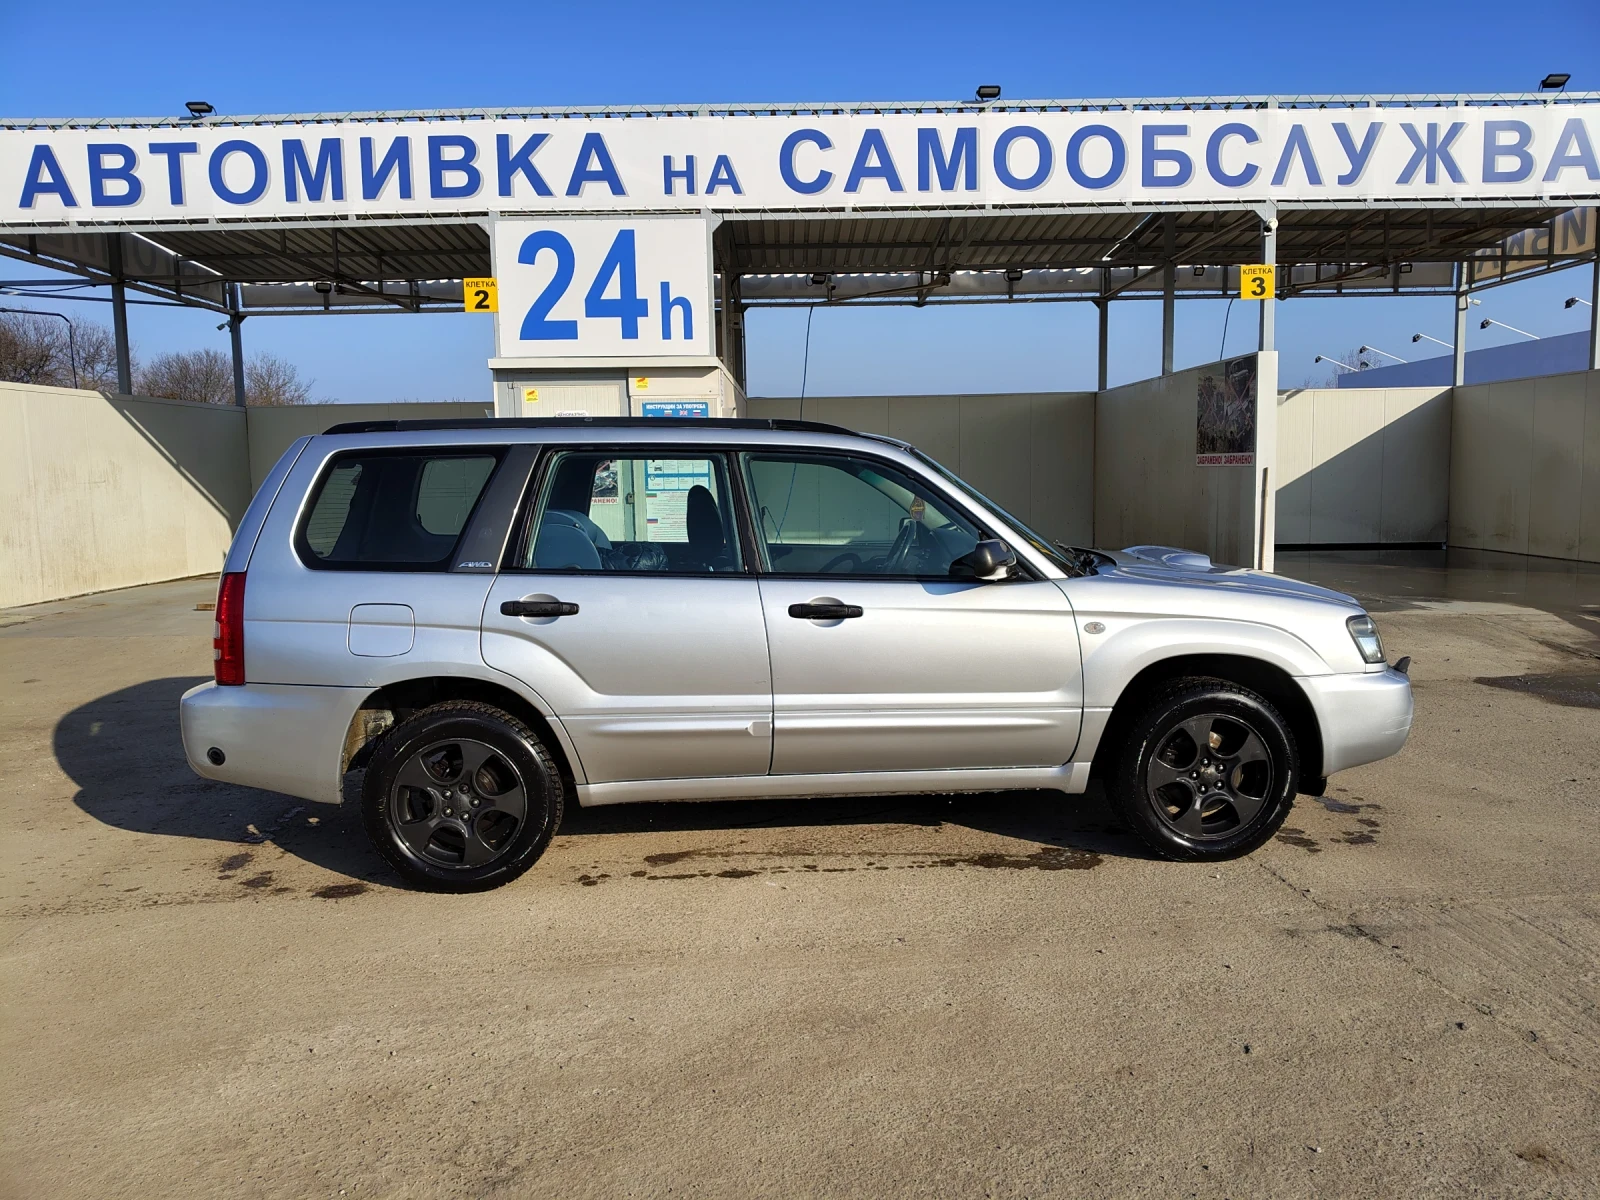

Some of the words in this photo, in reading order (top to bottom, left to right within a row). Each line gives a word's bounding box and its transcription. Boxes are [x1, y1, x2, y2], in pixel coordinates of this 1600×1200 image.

[18, 132, 628, 209] АВТОМИВКА
[779, 117, 1600, 196] САМООБСЛУЖВА
[1242, 267, 1273, 275] КЛЕТКА
[465, 280, 496, 288] КЛЕТКА
[517, 229, 649, 341] 24
[660, 281, 694, 341] h
[1251, 276, 1266, 297] 3
[474, 289, 490, 310] 2
